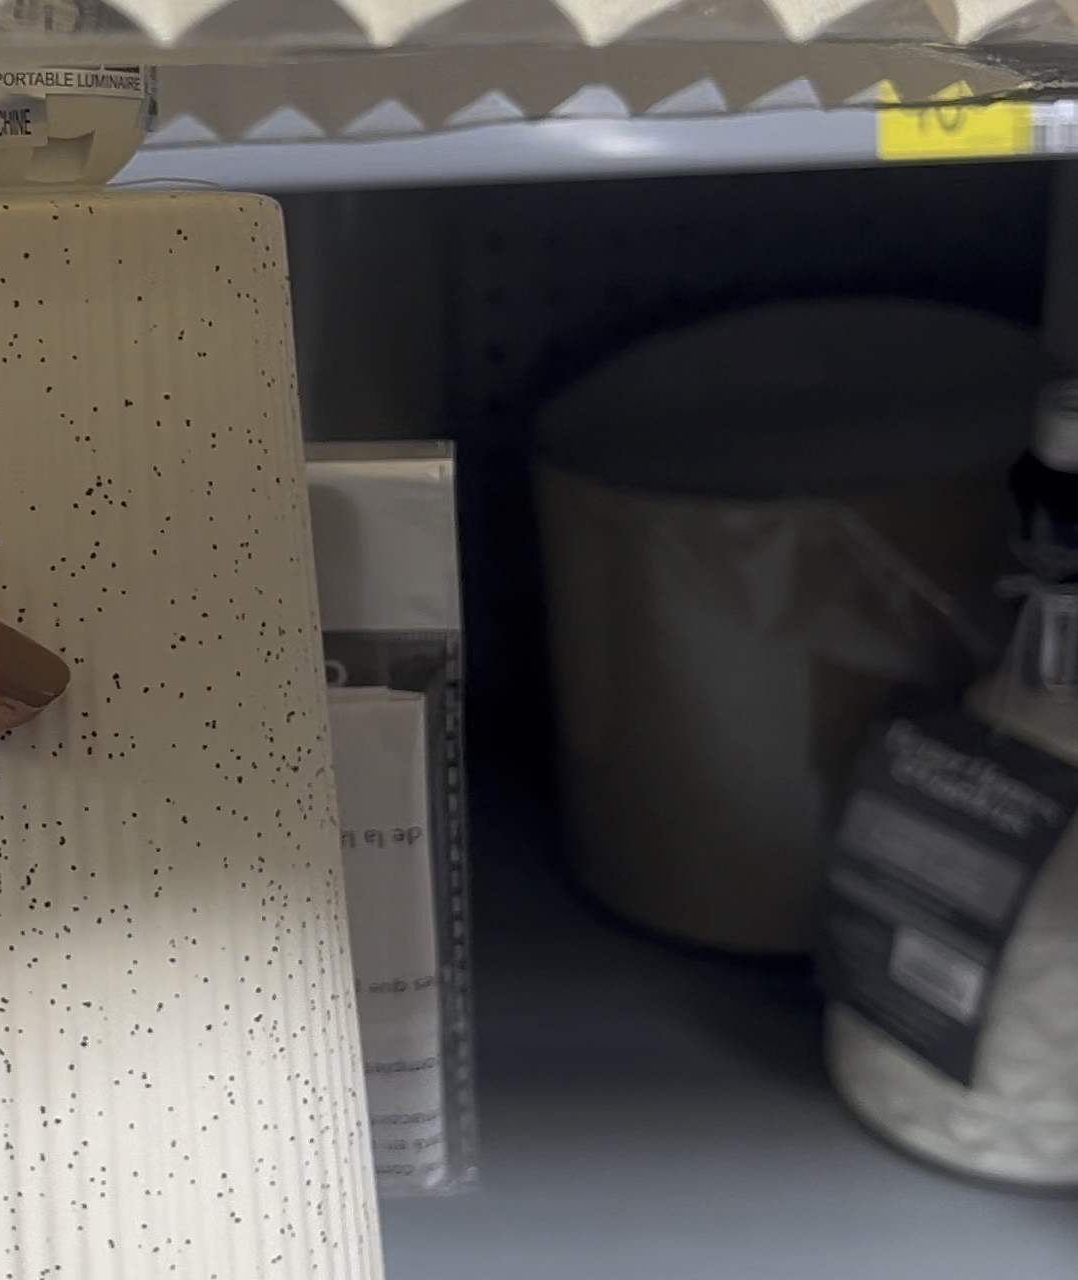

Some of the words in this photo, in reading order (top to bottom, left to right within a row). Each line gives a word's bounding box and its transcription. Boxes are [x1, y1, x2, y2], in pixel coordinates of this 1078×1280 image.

[77, 72, 141, 91] LUMINAIRE
[363, 828, 386, 849] la
[392, 826, 423, 846] de
